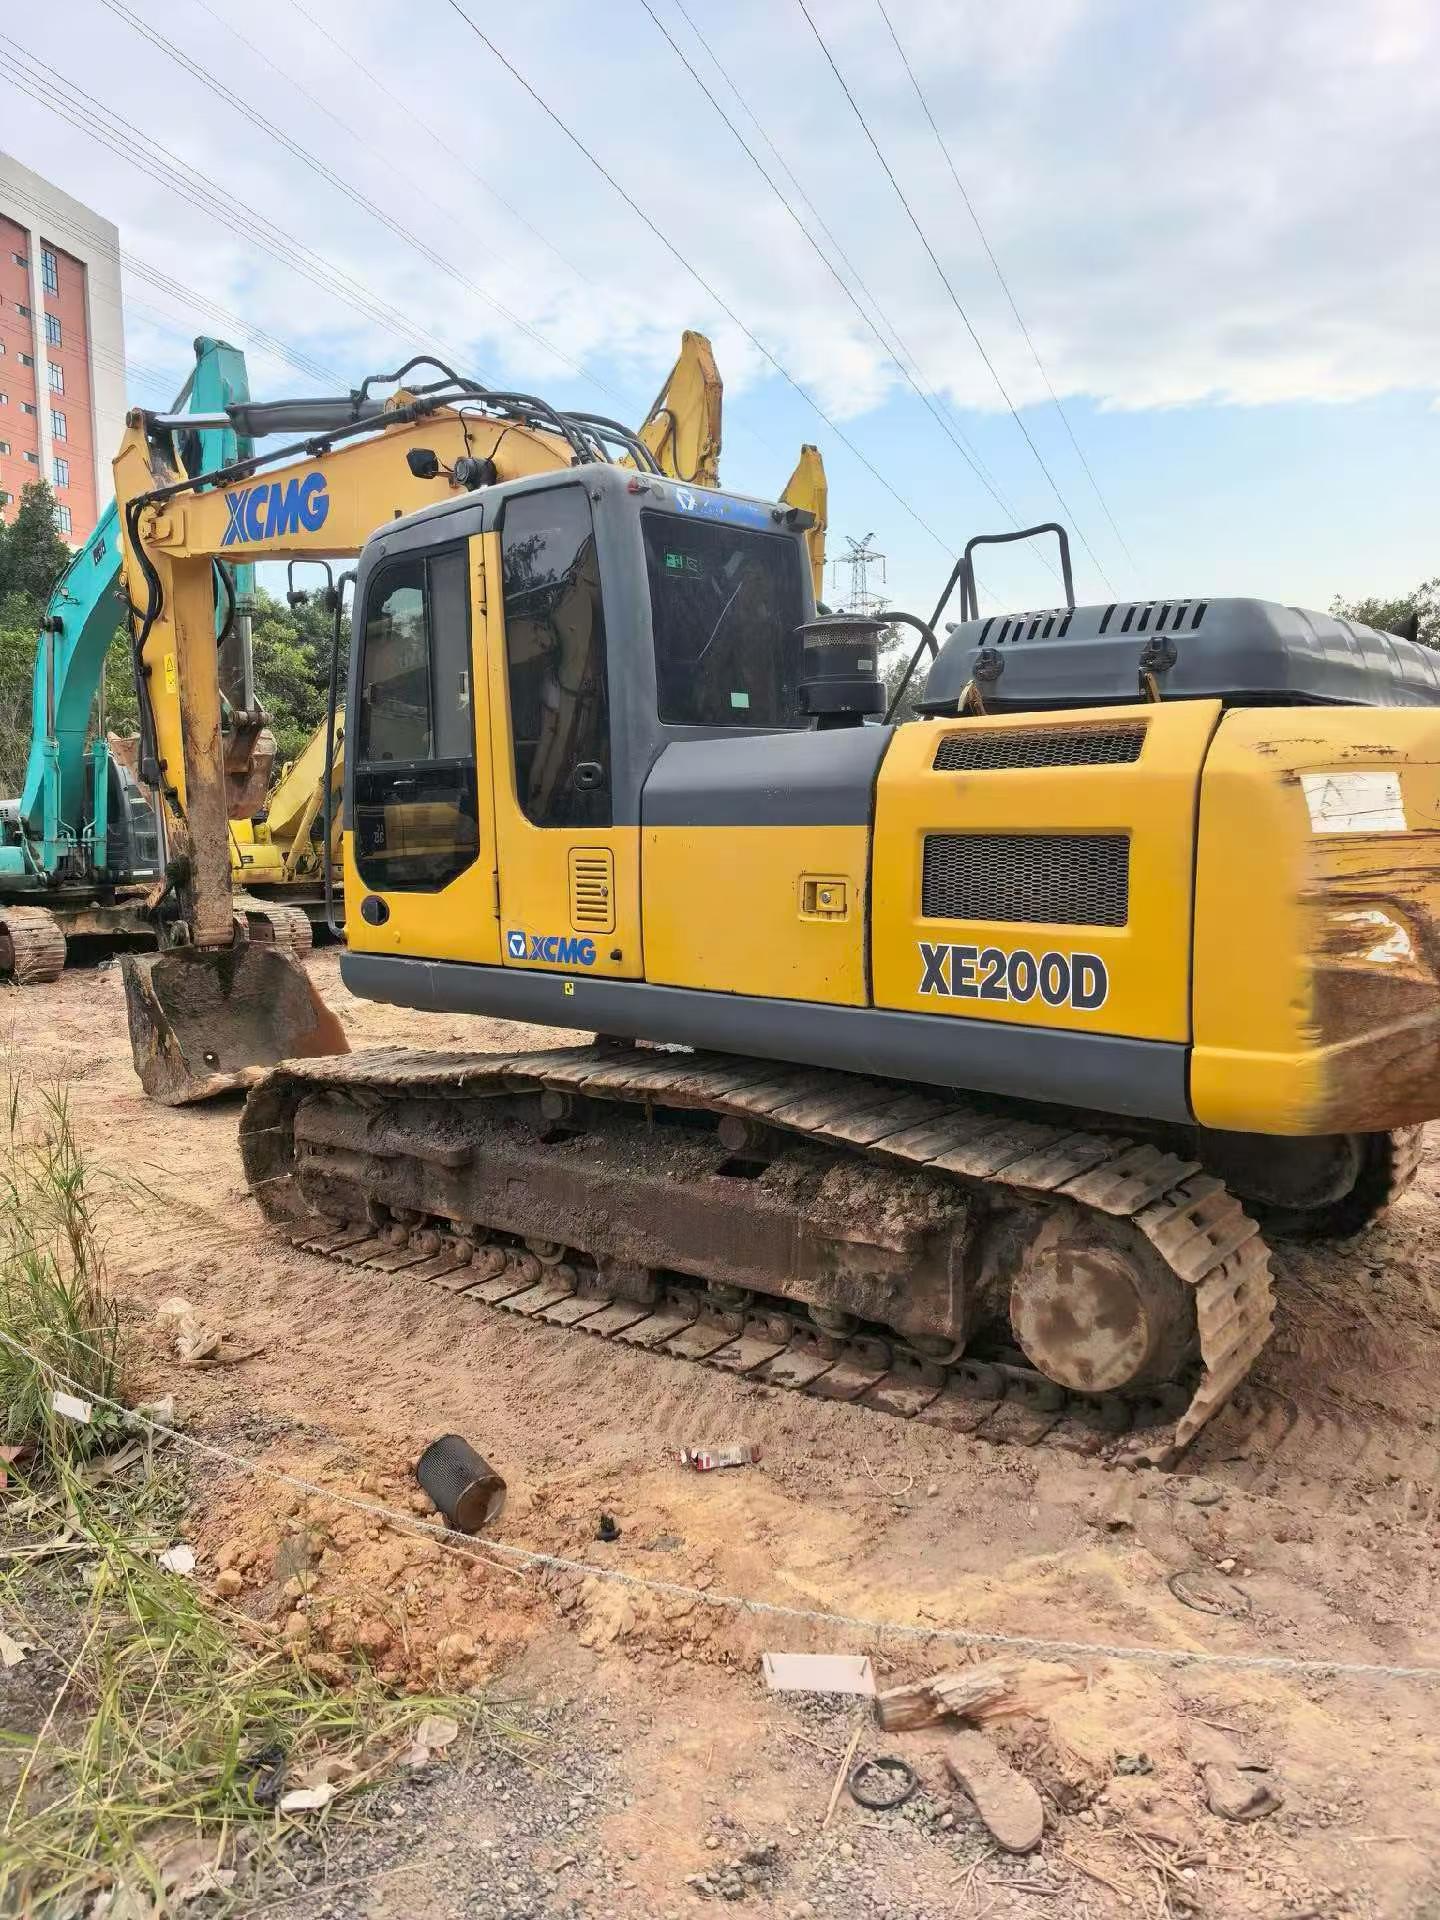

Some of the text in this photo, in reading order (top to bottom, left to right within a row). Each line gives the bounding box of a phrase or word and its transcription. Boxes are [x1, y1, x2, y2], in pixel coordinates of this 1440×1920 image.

[220, 472, 330, 547] XCMG
[528, 935, 596, 966] XCMG
[918, 942, 1109, 1011] XE200D
